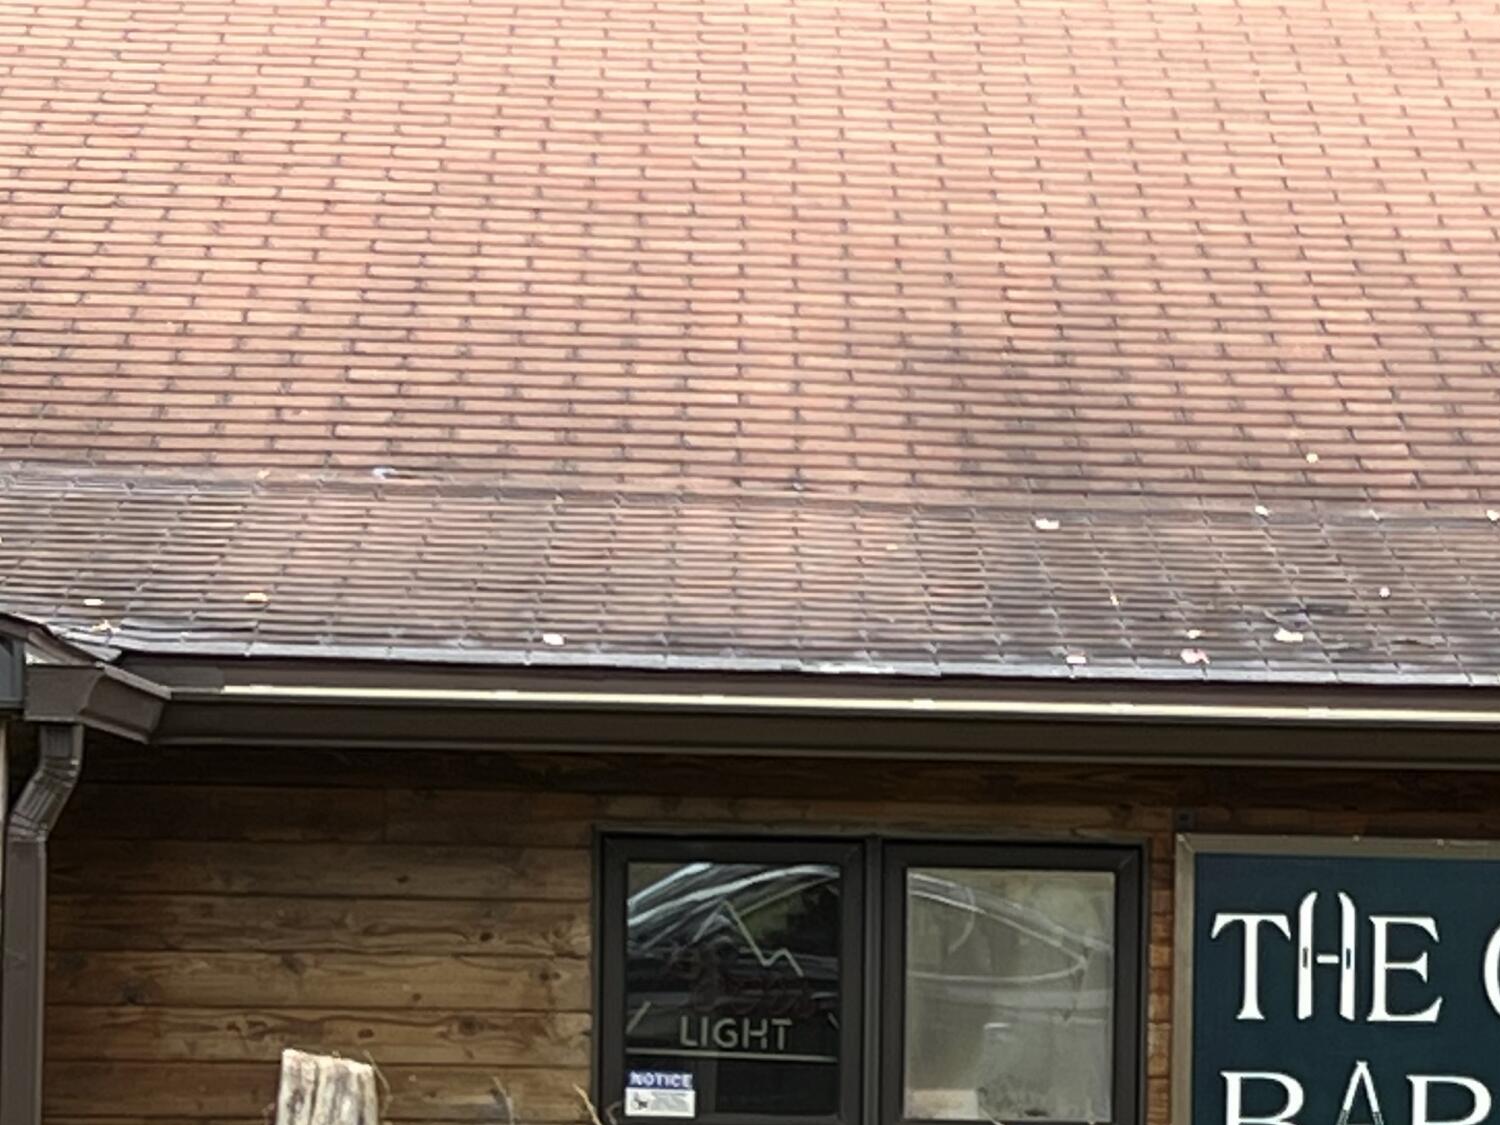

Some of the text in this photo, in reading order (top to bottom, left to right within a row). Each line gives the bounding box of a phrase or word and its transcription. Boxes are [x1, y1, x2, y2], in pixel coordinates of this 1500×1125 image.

[1211, 891, 1443, 1023] THE
[680, 1016, 793, 1051] LIGHT
[629, 1072, 693, 1088] NOTICE
